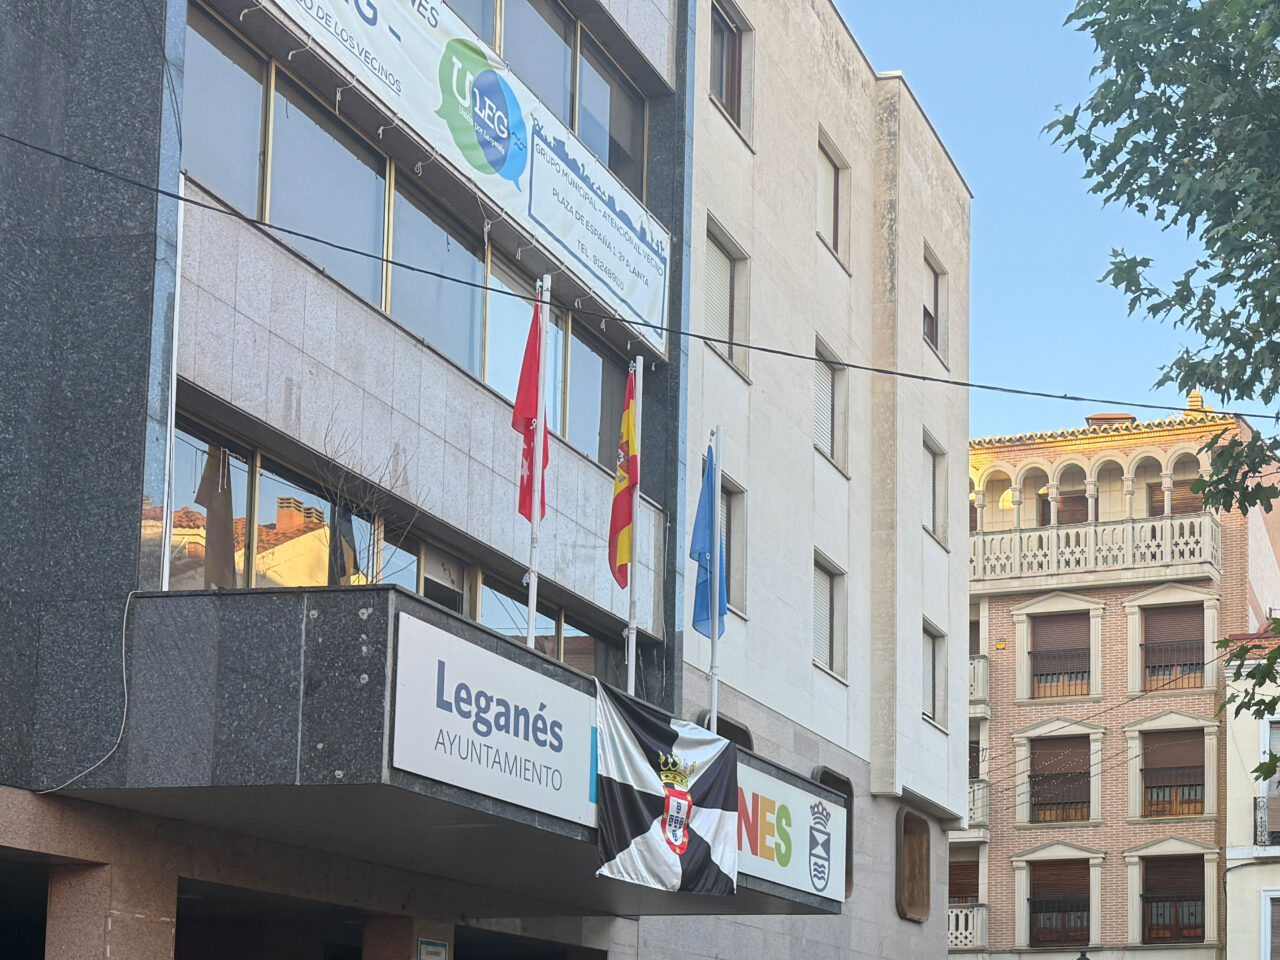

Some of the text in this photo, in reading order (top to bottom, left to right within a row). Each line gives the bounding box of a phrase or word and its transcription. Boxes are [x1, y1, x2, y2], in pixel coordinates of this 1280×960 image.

[316, 5, 332, 28] DE
[334, 21, 355, 50] LOS
[357, 42, 402, 93] VECINOS
[535, 143, 561, 174] GRUPO
[561, 170, 598, 211] MUNICIPAL
[633, 241, 643, 255] AL
[642, 250, 664, 277] VECINO
[552, 187, 574, 216] PLAZA
[574, 210, 585, 226] DE
[585, 217, 612, 250] ESPAÑA
[625, 260, 649, 287] PLANTA
[436, 659, 564, 753] Leganés
[434, 728, 563, 792] AYUNTAMIENTO
